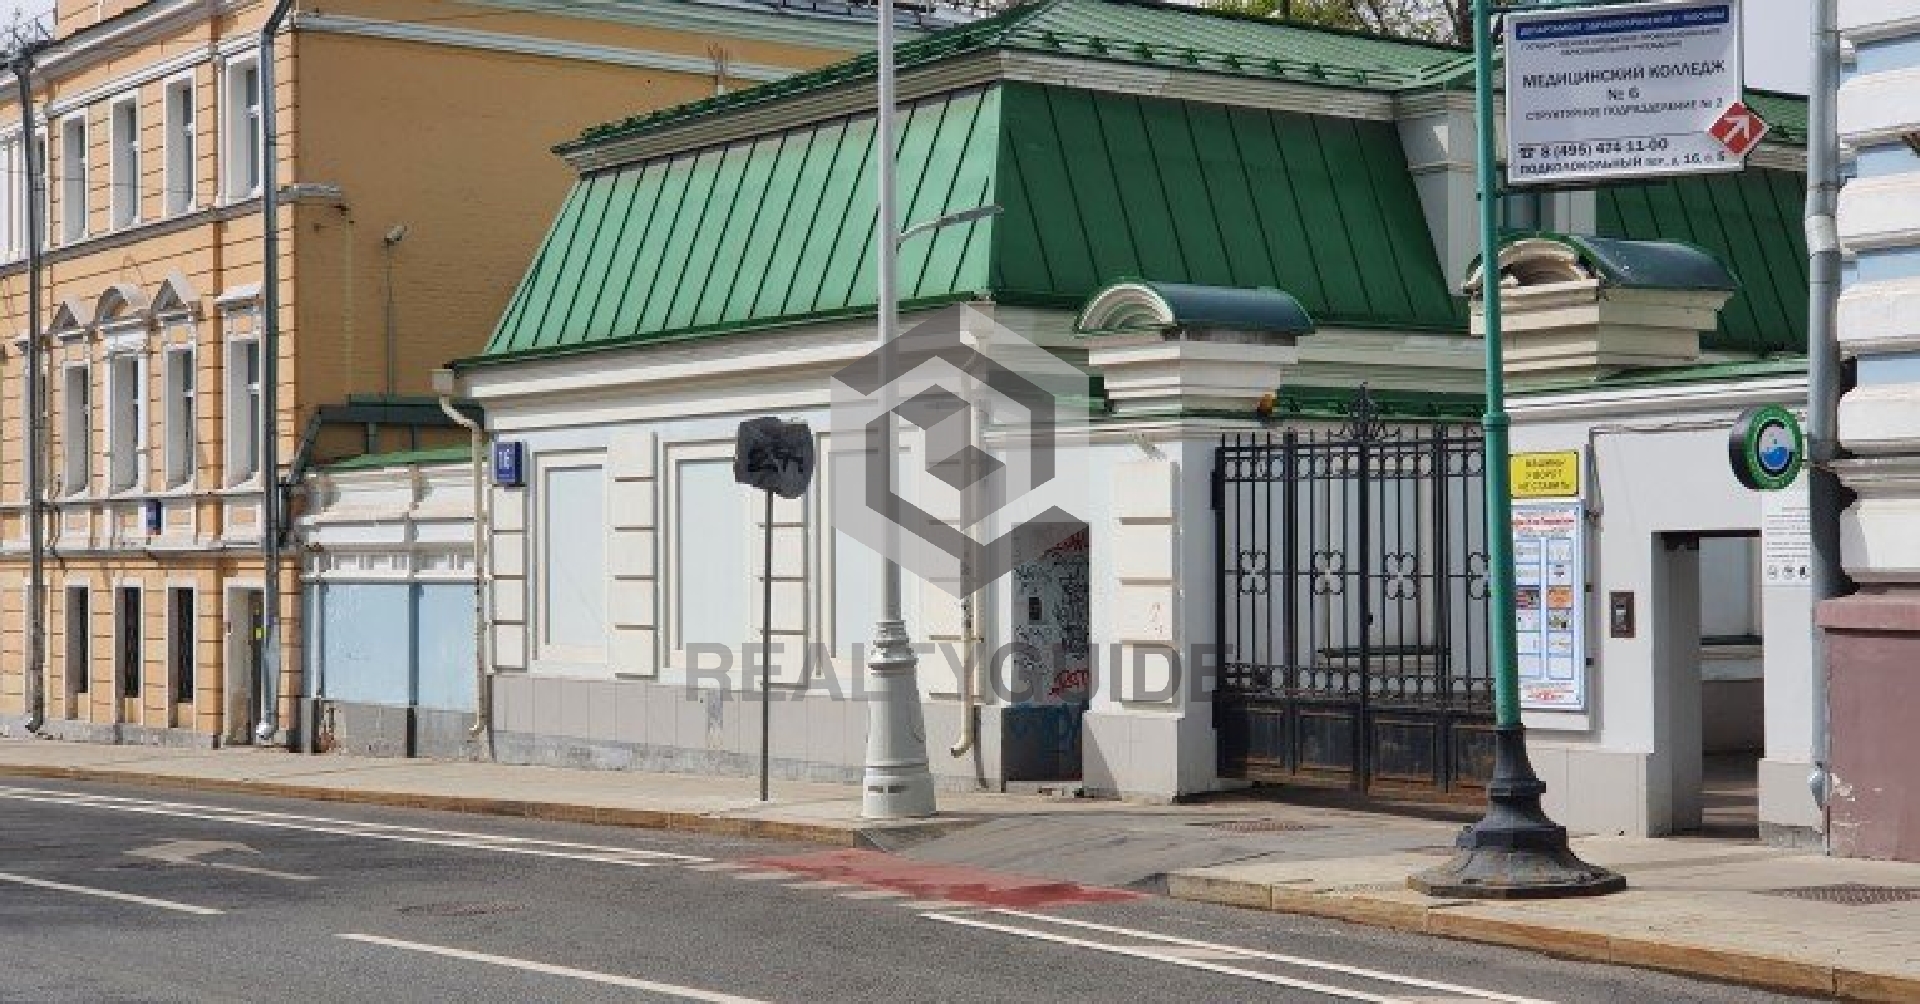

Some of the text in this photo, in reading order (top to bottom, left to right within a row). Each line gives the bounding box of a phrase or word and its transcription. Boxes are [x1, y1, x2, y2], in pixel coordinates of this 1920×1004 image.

[1522, 59, 1725, 89] МЕДИЦИНСКИЙ КОЛЛЕДЖ
[1628, 87, 1640, 99] 6
